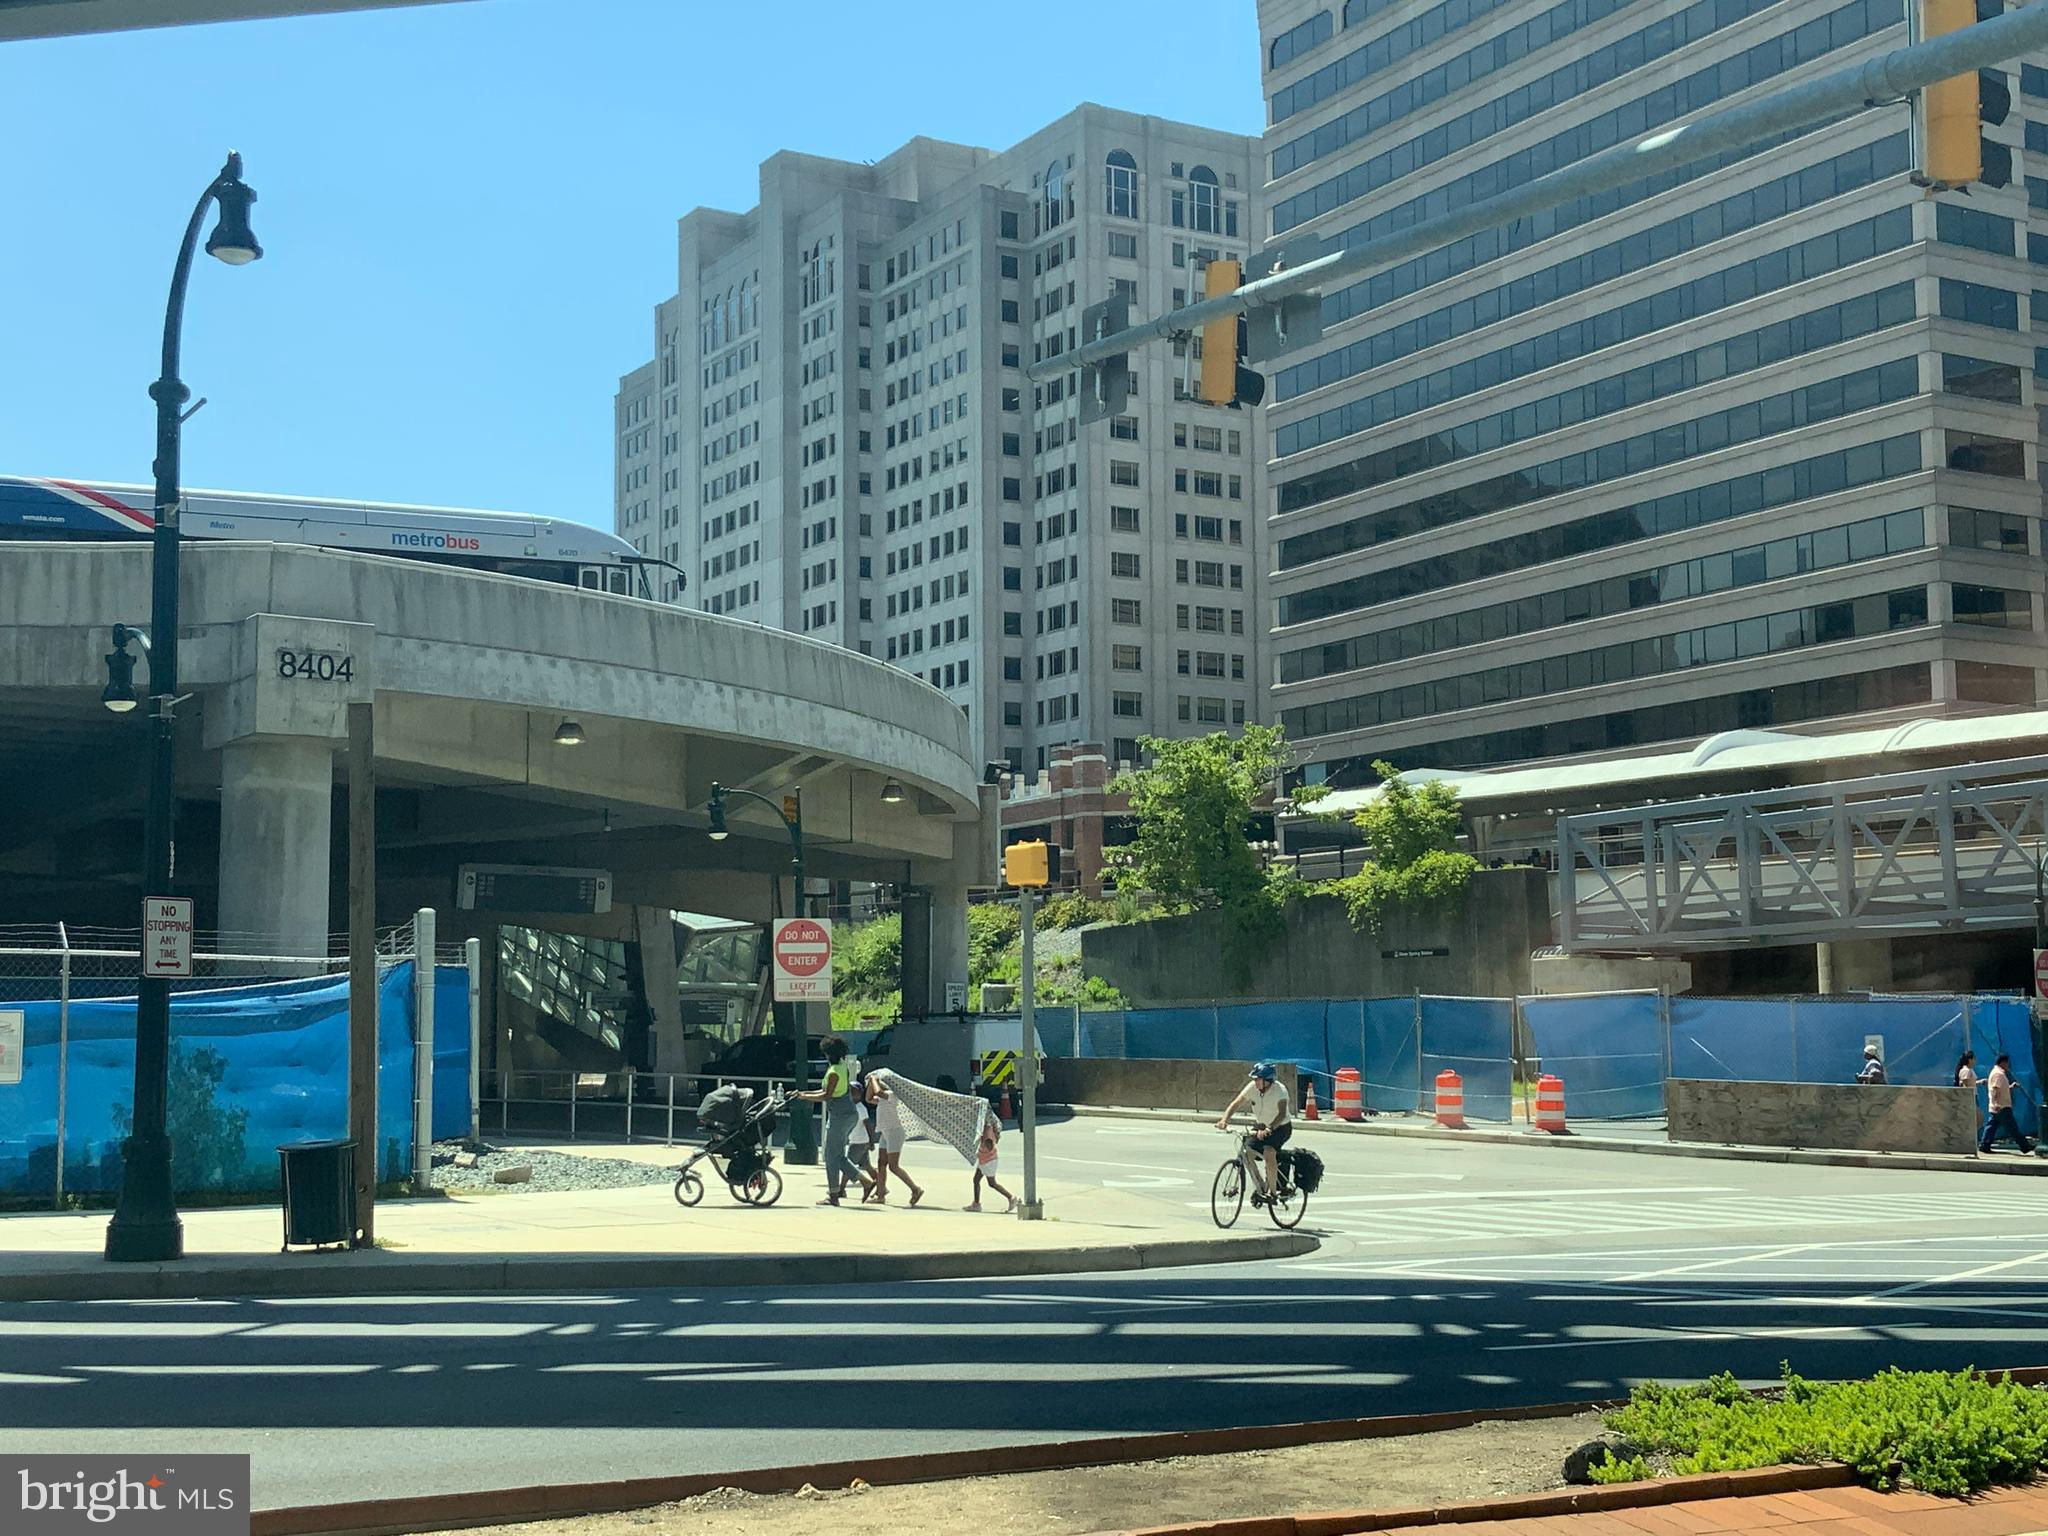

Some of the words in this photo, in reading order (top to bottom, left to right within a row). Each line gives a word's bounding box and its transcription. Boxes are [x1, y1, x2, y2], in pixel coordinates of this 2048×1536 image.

[392, 532, 479, 550] metrobus
[280, 651, 353, 682] 8404
[161, 906, 177, 917] NO
[147, 920, 191, 932] STOPPING
[160, 936, 177, 945] ANY
[785, 931, 798, 940] DO
[802, 931, 820, 940] NOT
[160, 949, 177, 959] TIME
[788, 956, 817, 966] ENTER
